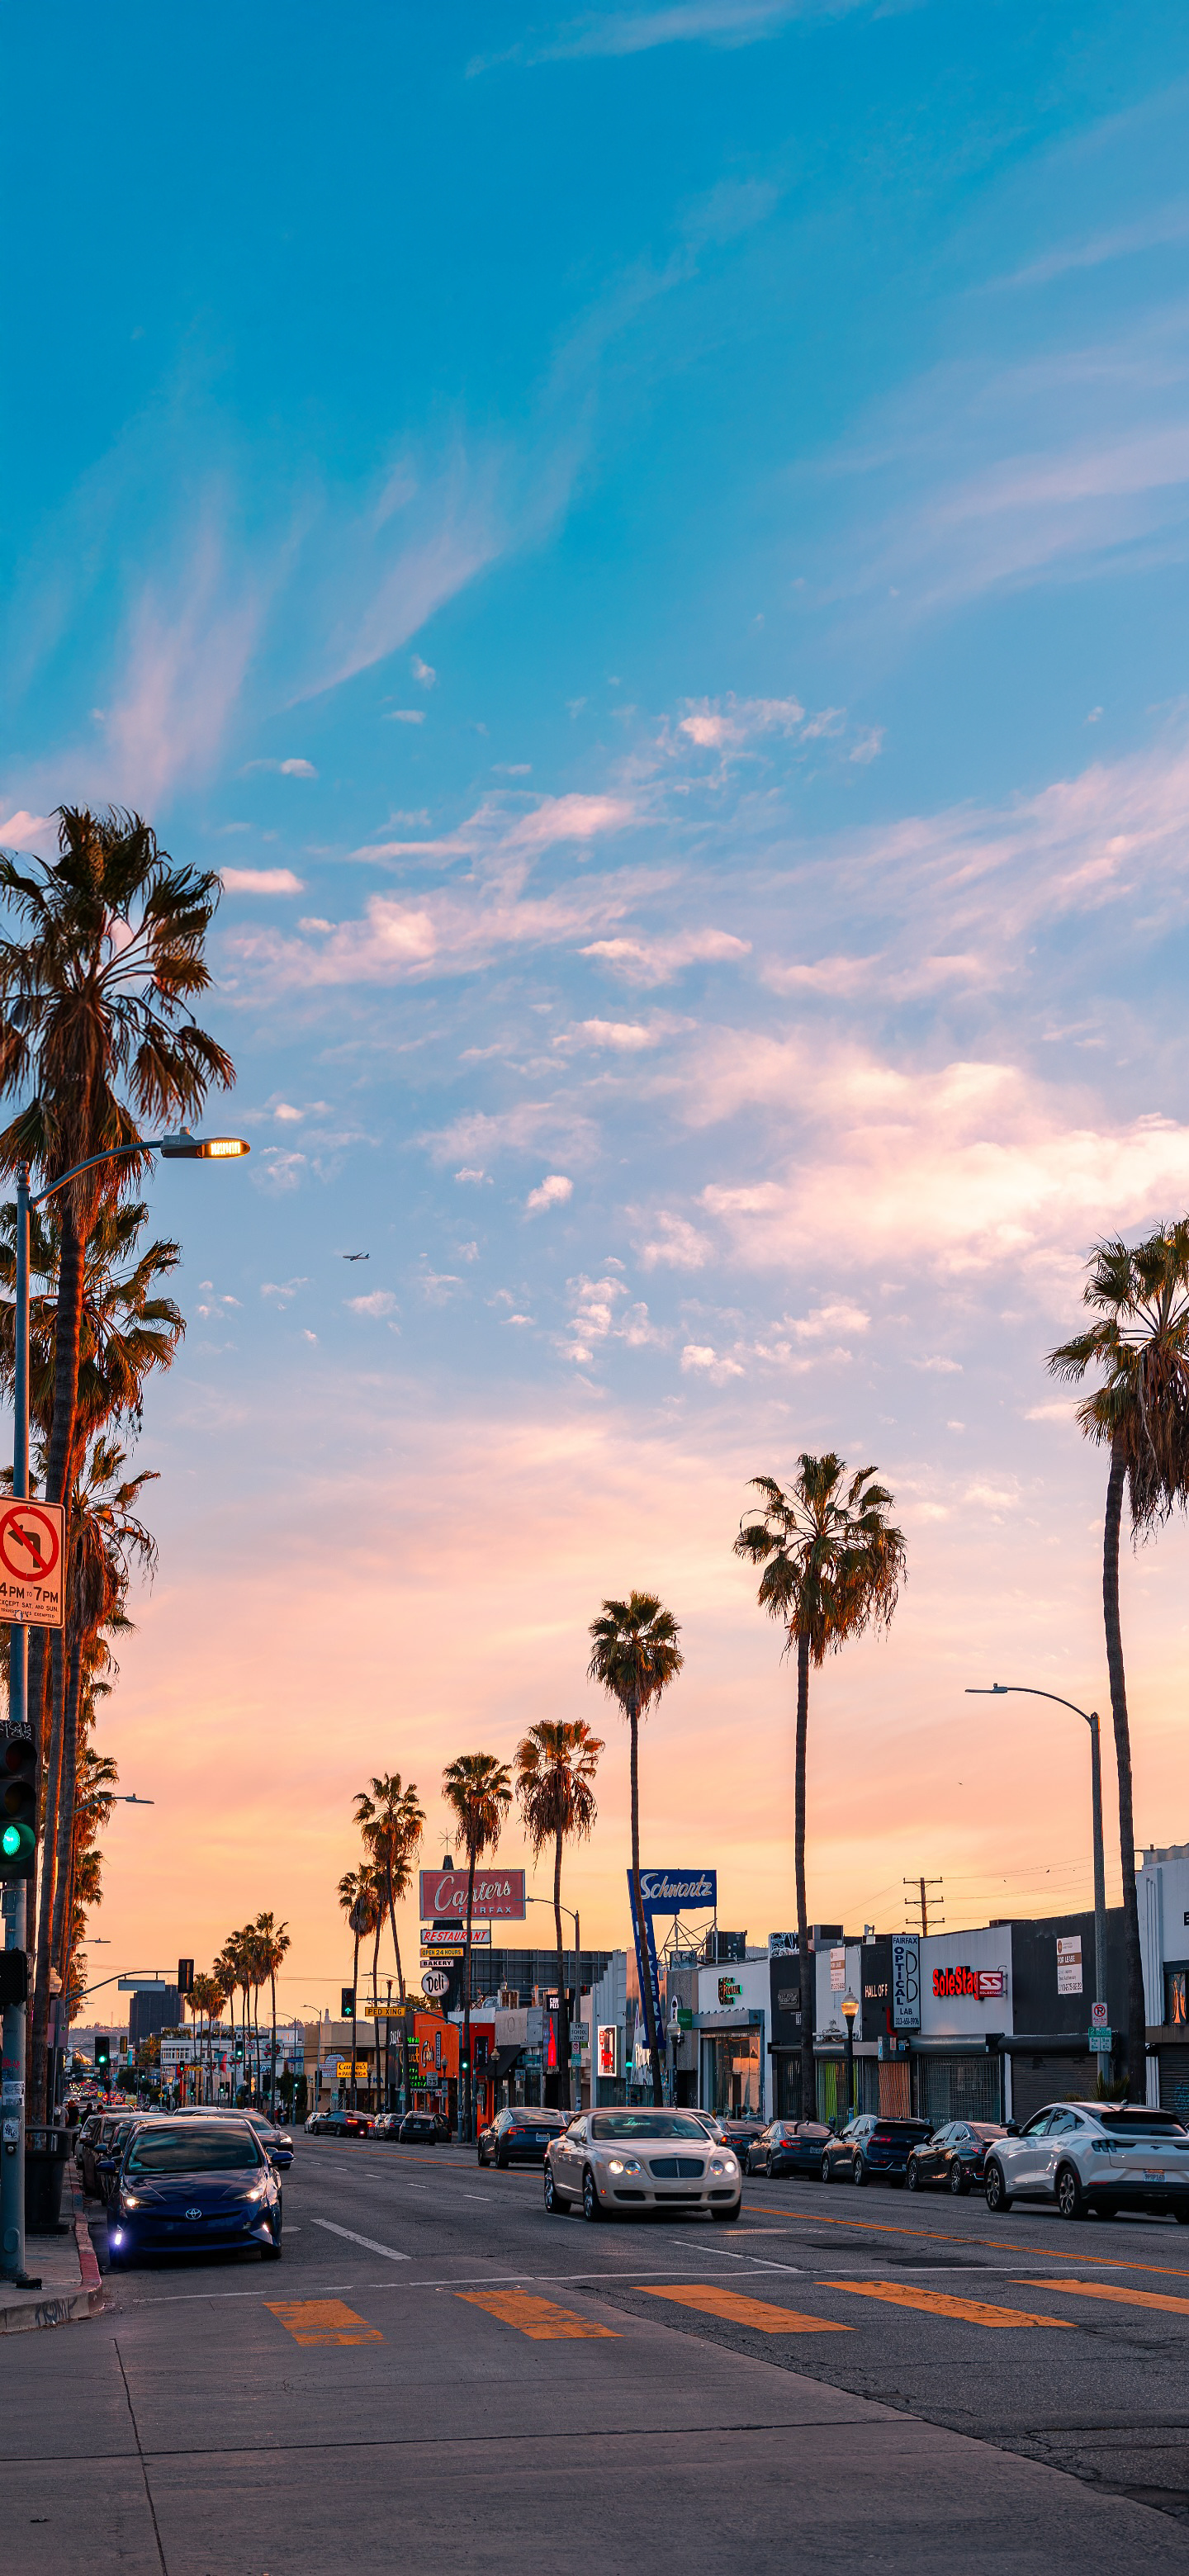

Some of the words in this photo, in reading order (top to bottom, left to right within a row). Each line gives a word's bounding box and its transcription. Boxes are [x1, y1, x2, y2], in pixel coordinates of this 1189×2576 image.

[33, 1586, 59, 1603] 7PM
[640, 1873, 713, 1900] Schwartz
[1064, 1955, 1075, 1963] LEASE
[425, 1972, 444, 1993] Deli
[894, 1946, 906, 2005] OPTICAL
[865, 1985, 877, 1998] HALL
[878, 1984, 884, 1997] OF
